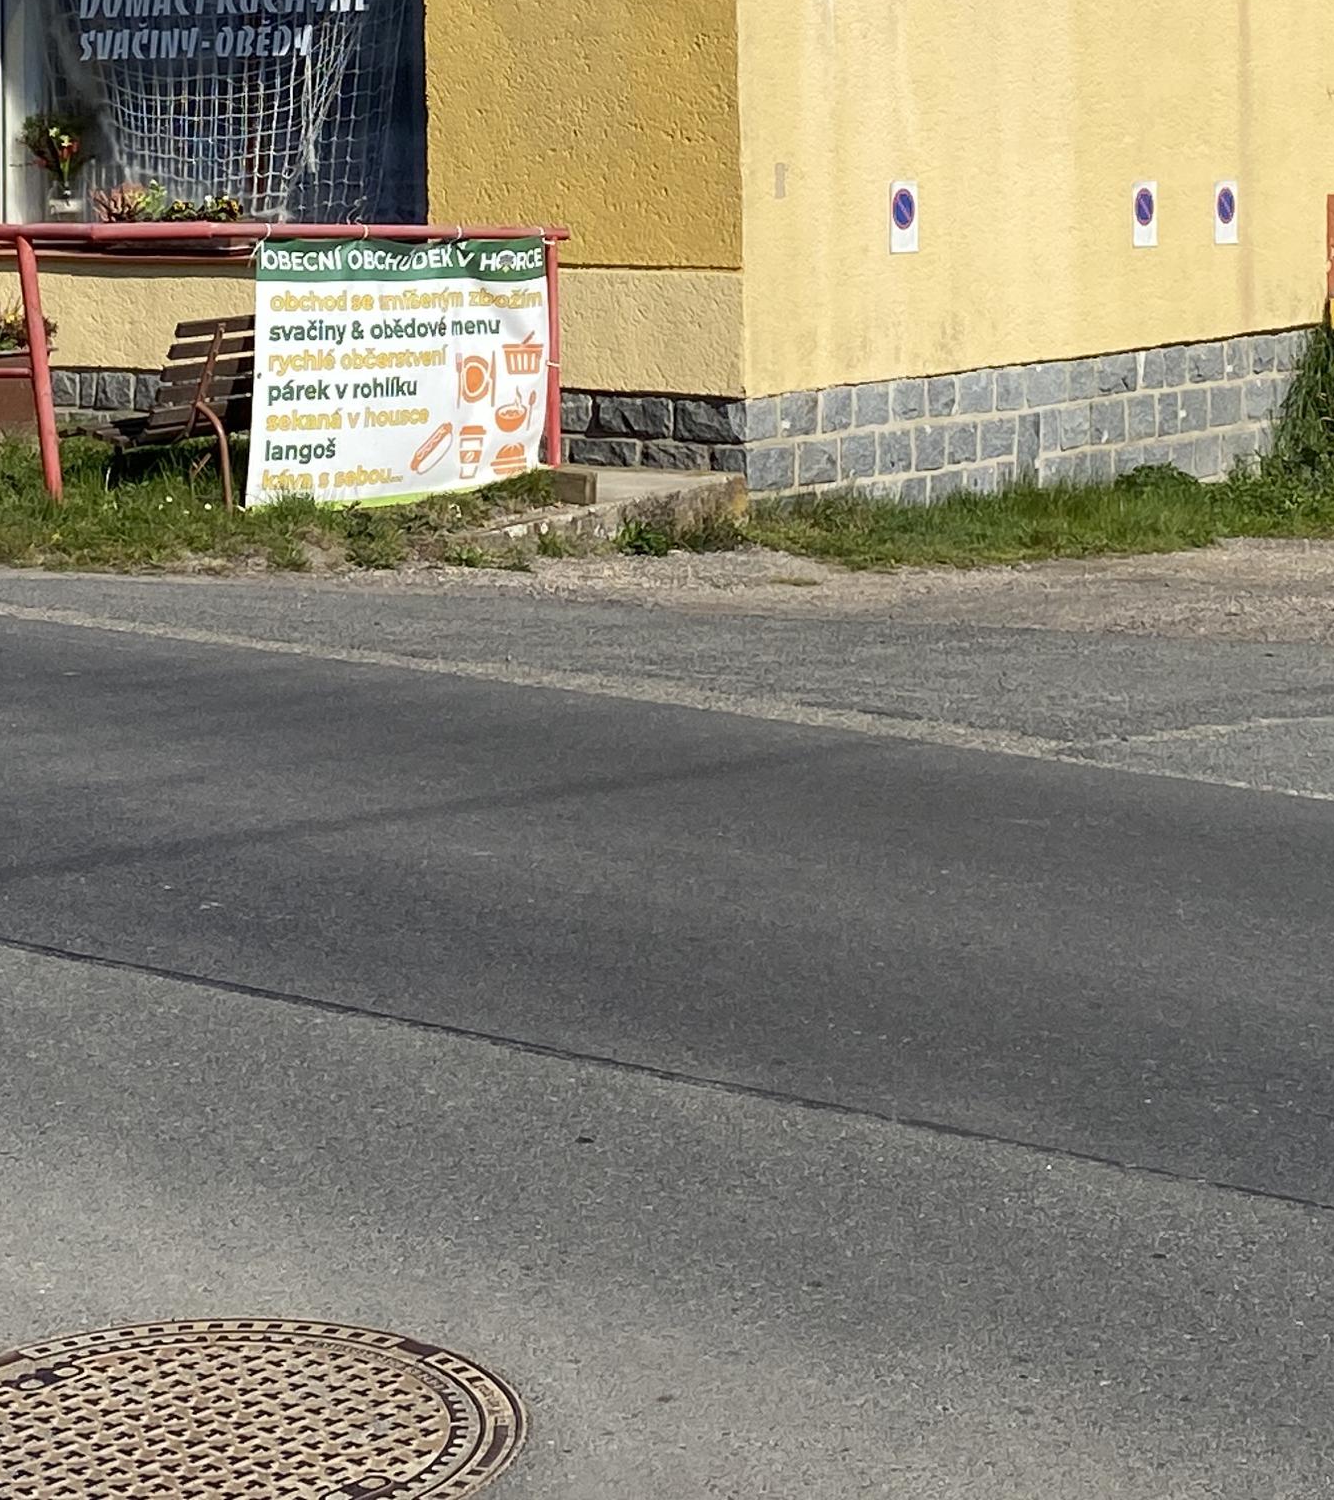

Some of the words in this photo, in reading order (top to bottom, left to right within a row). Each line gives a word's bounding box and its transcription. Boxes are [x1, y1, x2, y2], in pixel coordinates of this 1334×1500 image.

[266, 245, 343, 271] OBECNÍ
[479, 247, 543, 272] HORCE
[269, 290, 347, 312] obchod
[350, 294, 375, 312] se
[468, 287, 543, 310] zbožím
[268, 319, 347, 346] svačiny
[351, 320, 365, 340] &
[370, 316, 448, 341] obědové
[451, 319, 501, 337] menu
[268, 348, 336, 376] rychlé
[340, 344, 449, 371] občerstvení
[267, 379, 331, 406] párek
[335, 383, 349, 400] v
[352, 376, 418, 400] rohlíku
[265, 407, 344, 432] sekaná
[347, 411, 361, 429] v
[364, 406, 430, 429] housce
[264, 437, 337, 465] langoš
[317, 472, 330, 489] s
